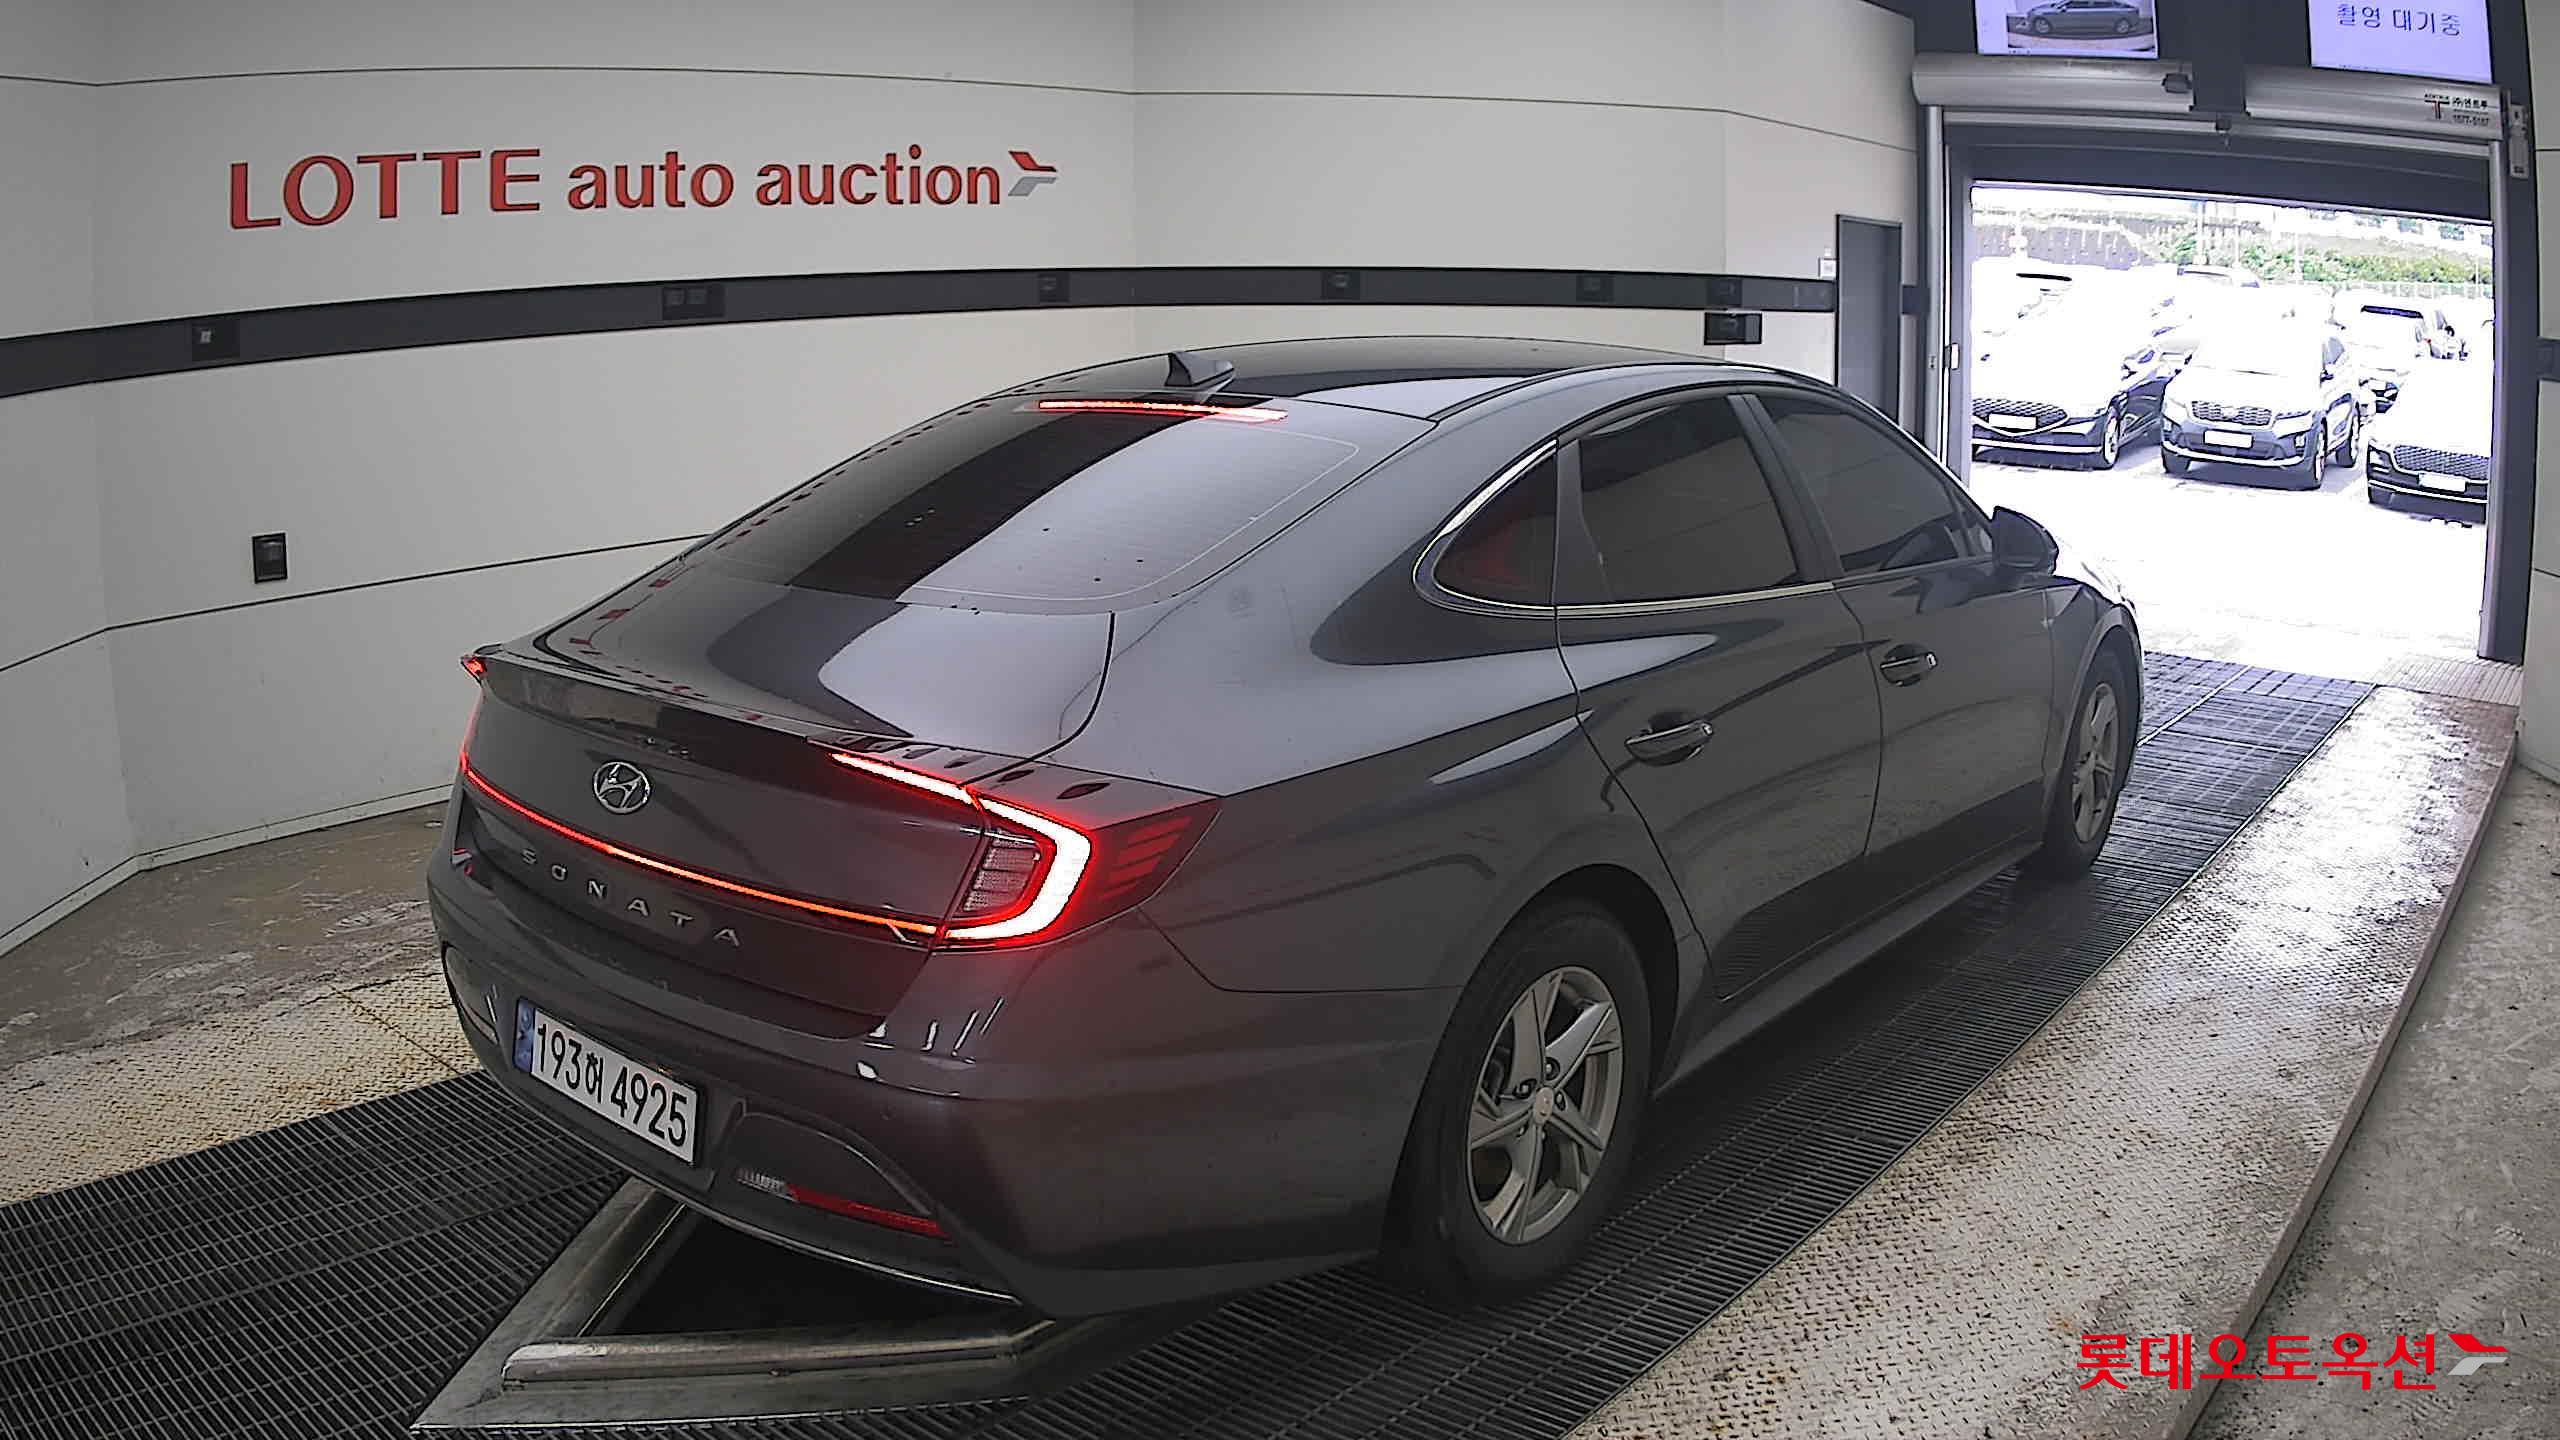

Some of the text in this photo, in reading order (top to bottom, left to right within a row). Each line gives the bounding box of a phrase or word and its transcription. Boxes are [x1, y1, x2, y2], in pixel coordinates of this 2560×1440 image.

[2337, 4, 2460, 36] 촬영 대기중
[230, 145, 1001, 229] LOTTE auto auction
[522, 849, 741, 947] SONATA
